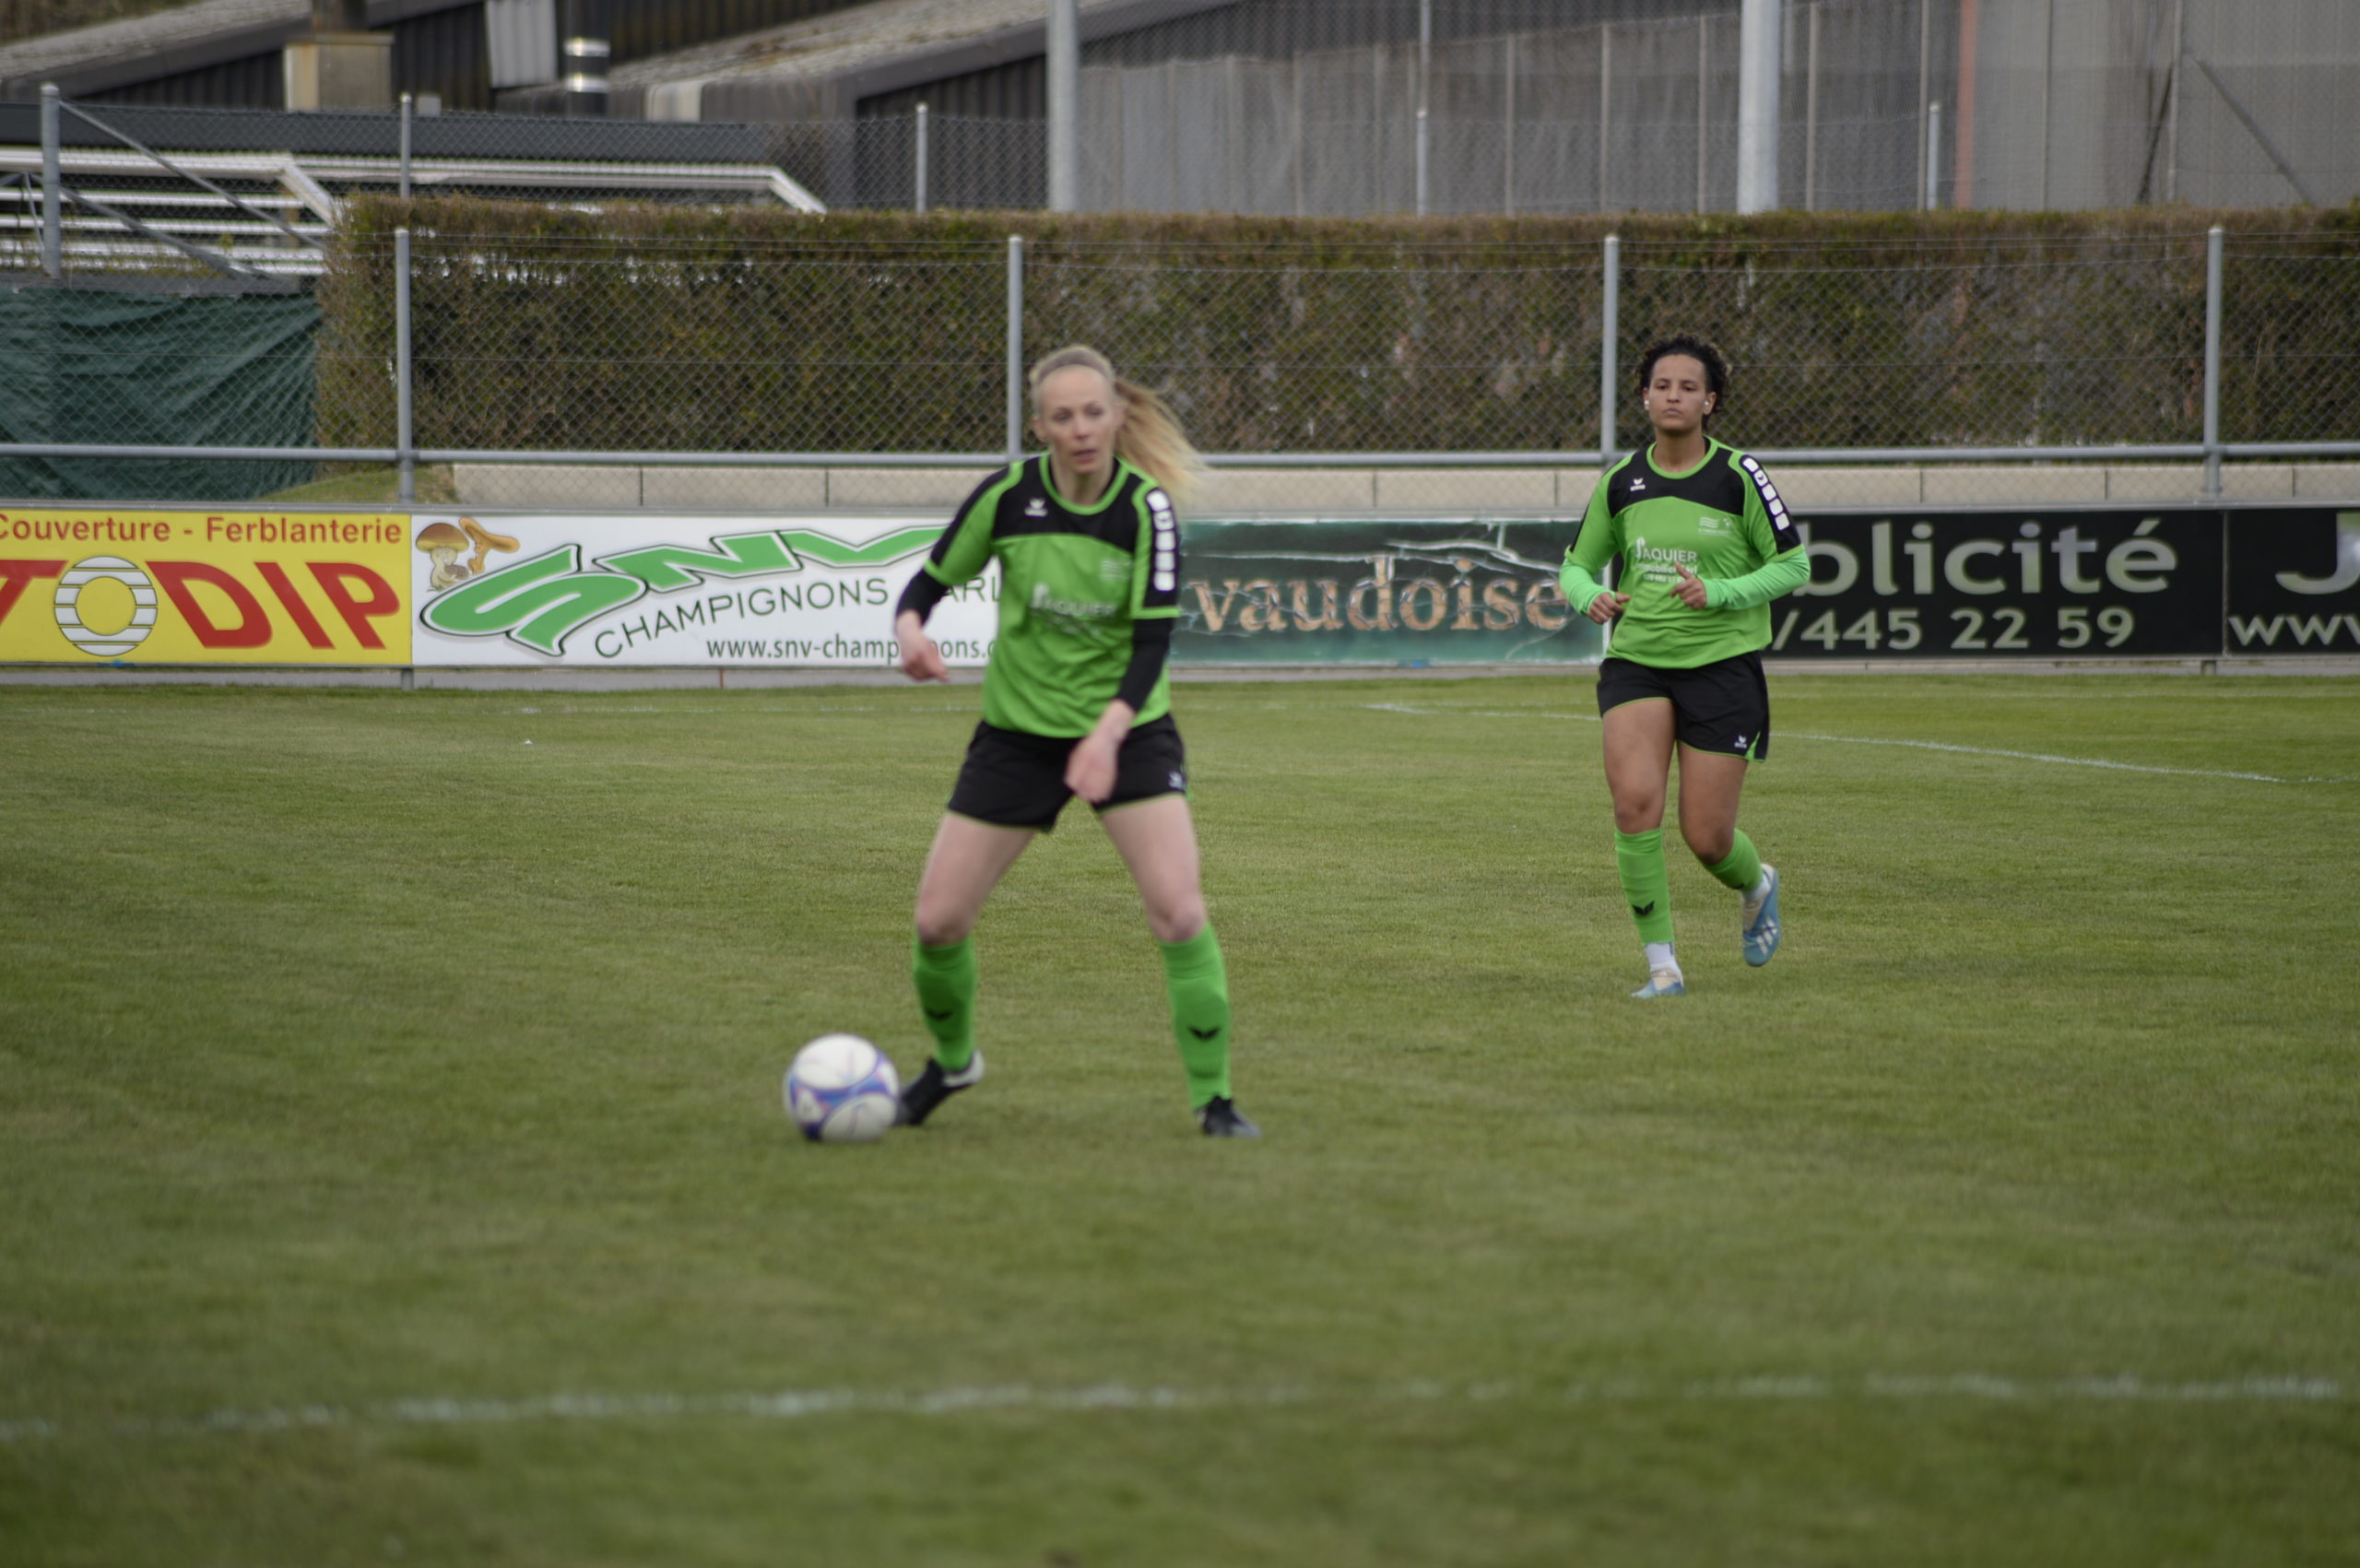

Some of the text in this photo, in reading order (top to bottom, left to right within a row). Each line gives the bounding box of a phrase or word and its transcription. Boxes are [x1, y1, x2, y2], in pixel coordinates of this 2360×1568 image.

[206, 516, 402, 544] Ferblanterie
[1792, 518, 2178, 595] blicité
[595, 578, 890, 659] CHAMPIGNONS
[1188, 554, 1567, 631] vaudoise
[1759, 607, 2136, 651] /445 22 59
